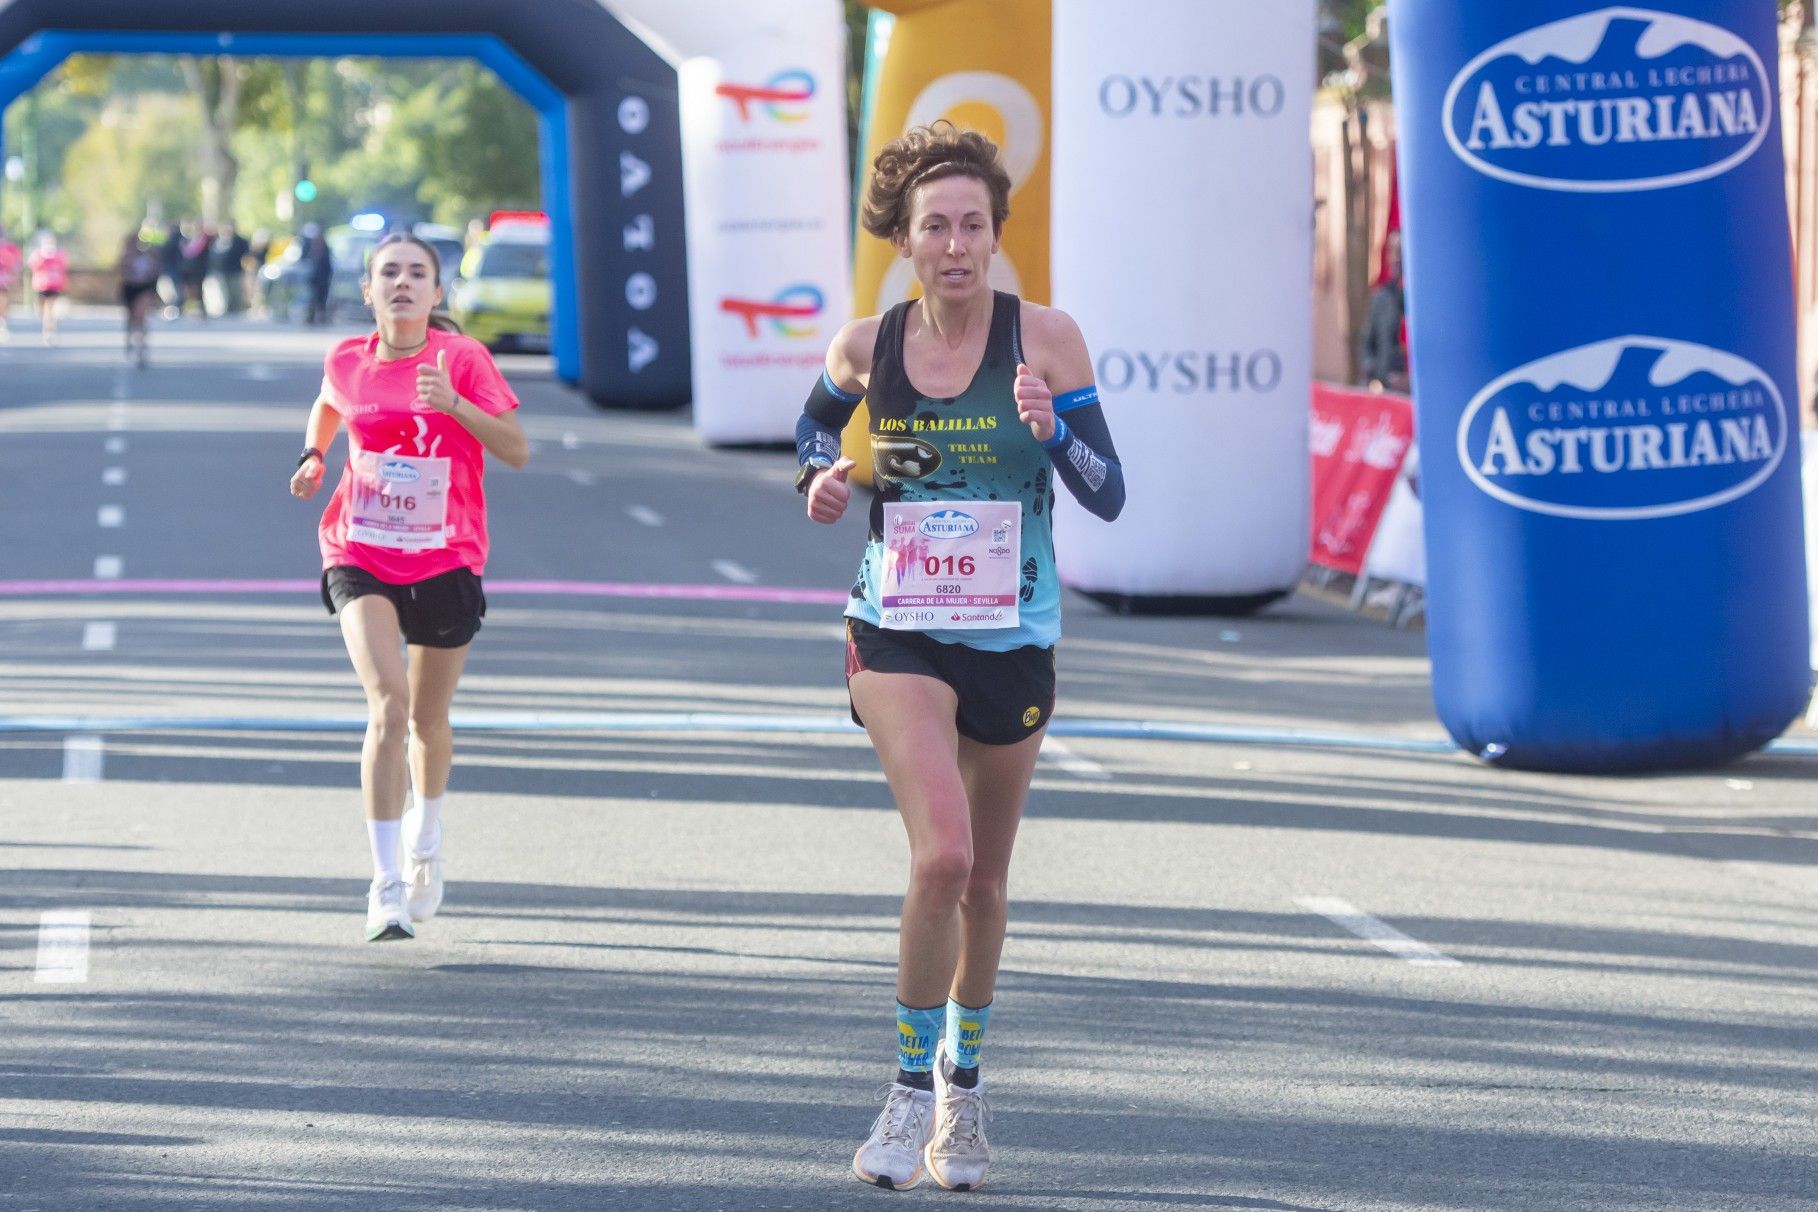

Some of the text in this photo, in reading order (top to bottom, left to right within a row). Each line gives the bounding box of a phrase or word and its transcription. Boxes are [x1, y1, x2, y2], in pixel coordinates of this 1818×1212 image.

[1515, 63, 1750, 94] CENTRAL LECHERA
[1098, 73, 1285, 119] OYSHO
[1465, 80, 1759, 150] ASTURIANA
[617, 95, 660, 374] VOLVO
[1097, 348, 1283, 394] OYSHO
[1527, 390, 1765, 422] CENTRAL LECHERA
[879, 416, 997, 432] LOS BALILLAS
[948, 443, 992, 453] TRAIL
[1480, 406, 1775, 476] ASTURIANA
[959, 456, 997, 464] TEAM
[381, 495, 416, 510] 016
[923, 522, 975, 533] ASTURIANA
[924, 555, 976, 576] 016
[936, 584, 961, 594] 6820
[973, 597, 999, 605] SEVILLA
[894, 612, 934, 622] OYSHO
